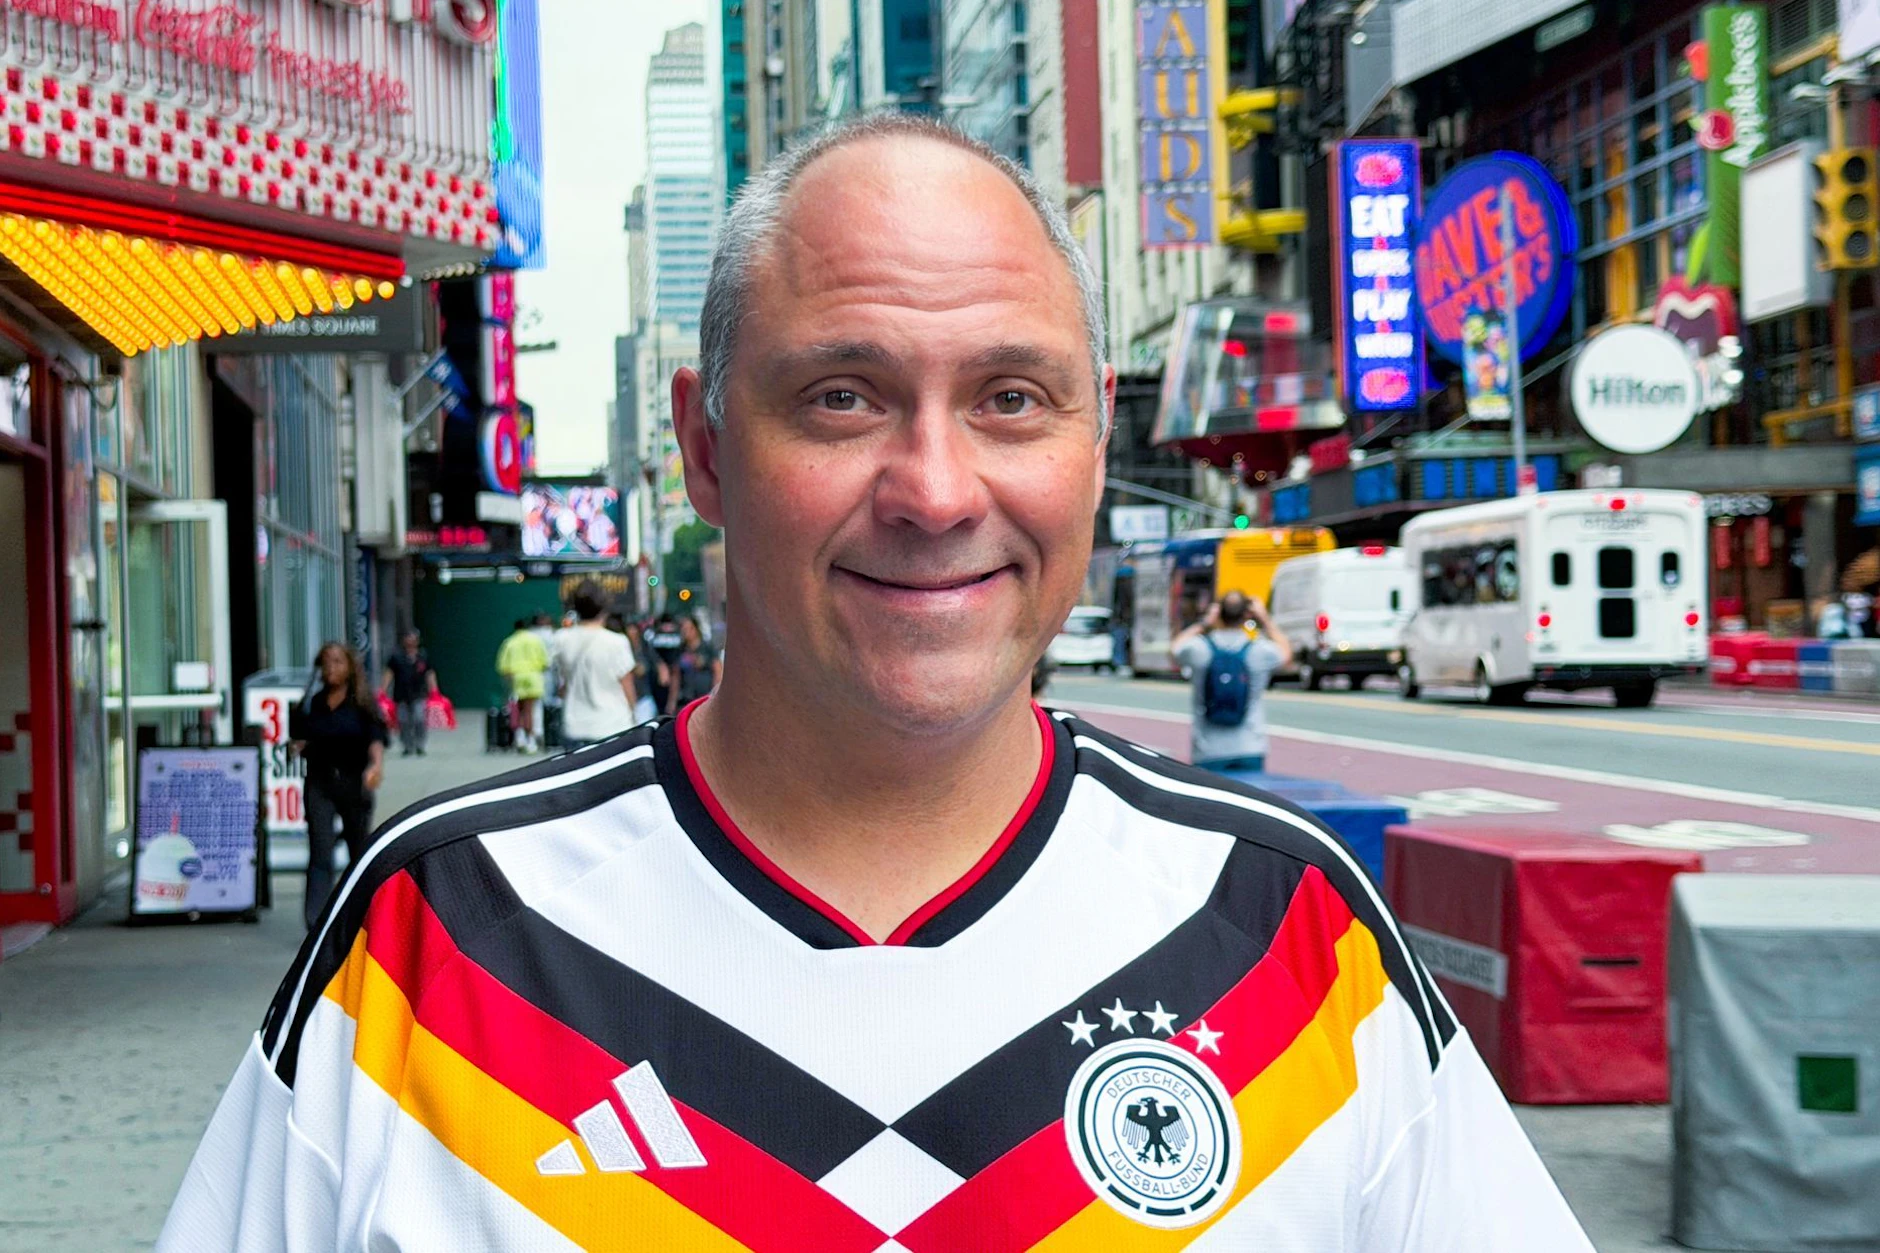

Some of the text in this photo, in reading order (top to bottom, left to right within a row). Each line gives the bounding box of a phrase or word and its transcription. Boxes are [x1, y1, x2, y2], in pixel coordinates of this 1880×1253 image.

[1350, 195, 1409, 238] EAT
[1589, 375, 1686, 405] Hilton
[1106, 1071, 1192, 1101] DEUTSCHER
[1107, 1150, 1209, 1196] FUSSBALL-BUND
